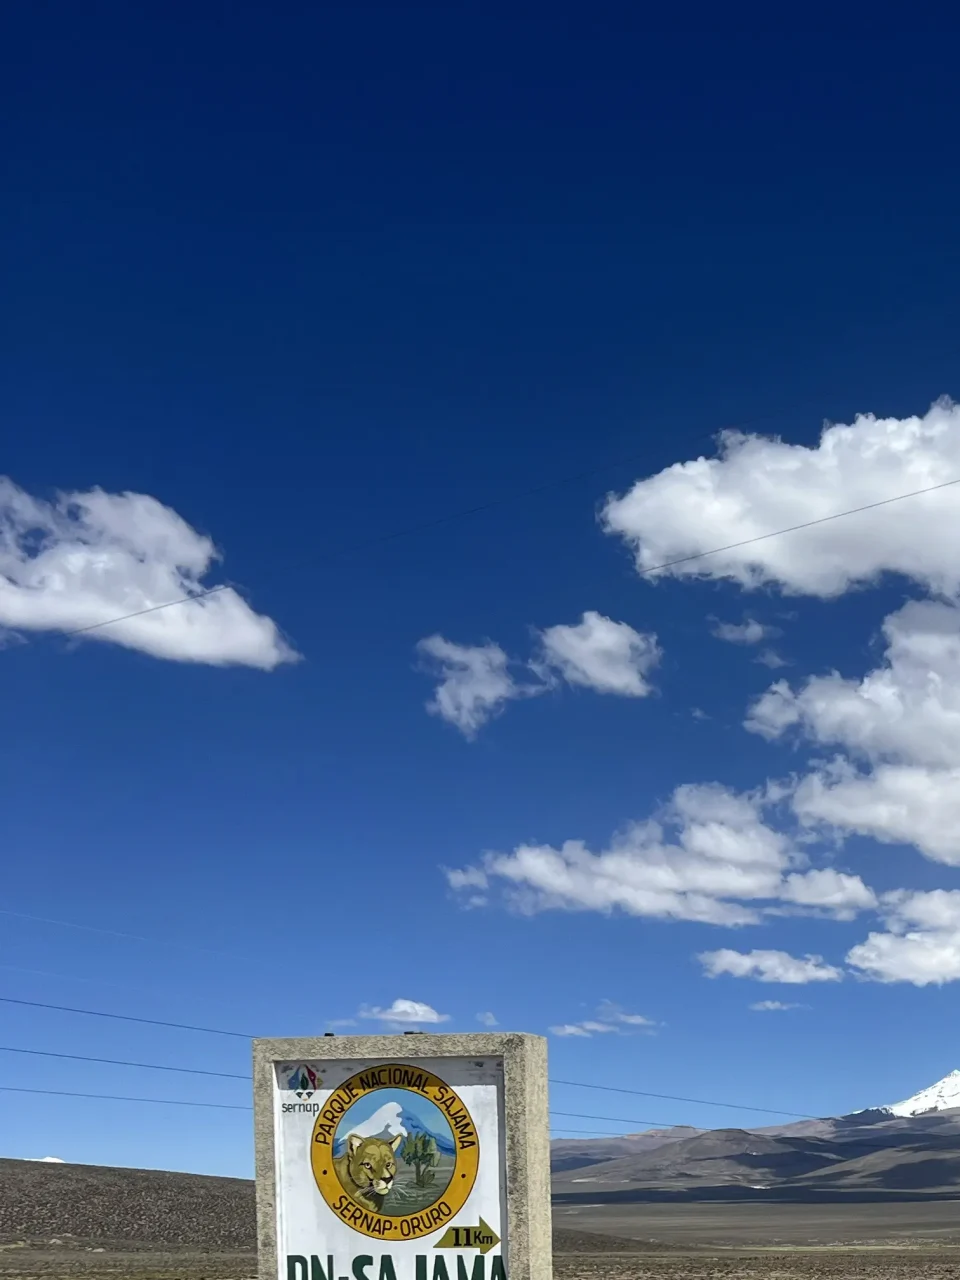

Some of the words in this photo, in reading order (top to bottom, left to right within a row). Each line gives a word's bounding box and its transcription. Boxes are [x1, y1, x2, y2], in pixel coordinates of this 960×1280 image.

[281, 1102, 320, 1118] sernap
[314, 1081, 360, 1146] PARQUE
[358, 1067, 430, 1095] NACIONAL
[432, 1086, 476, 1150] SAJAMA
